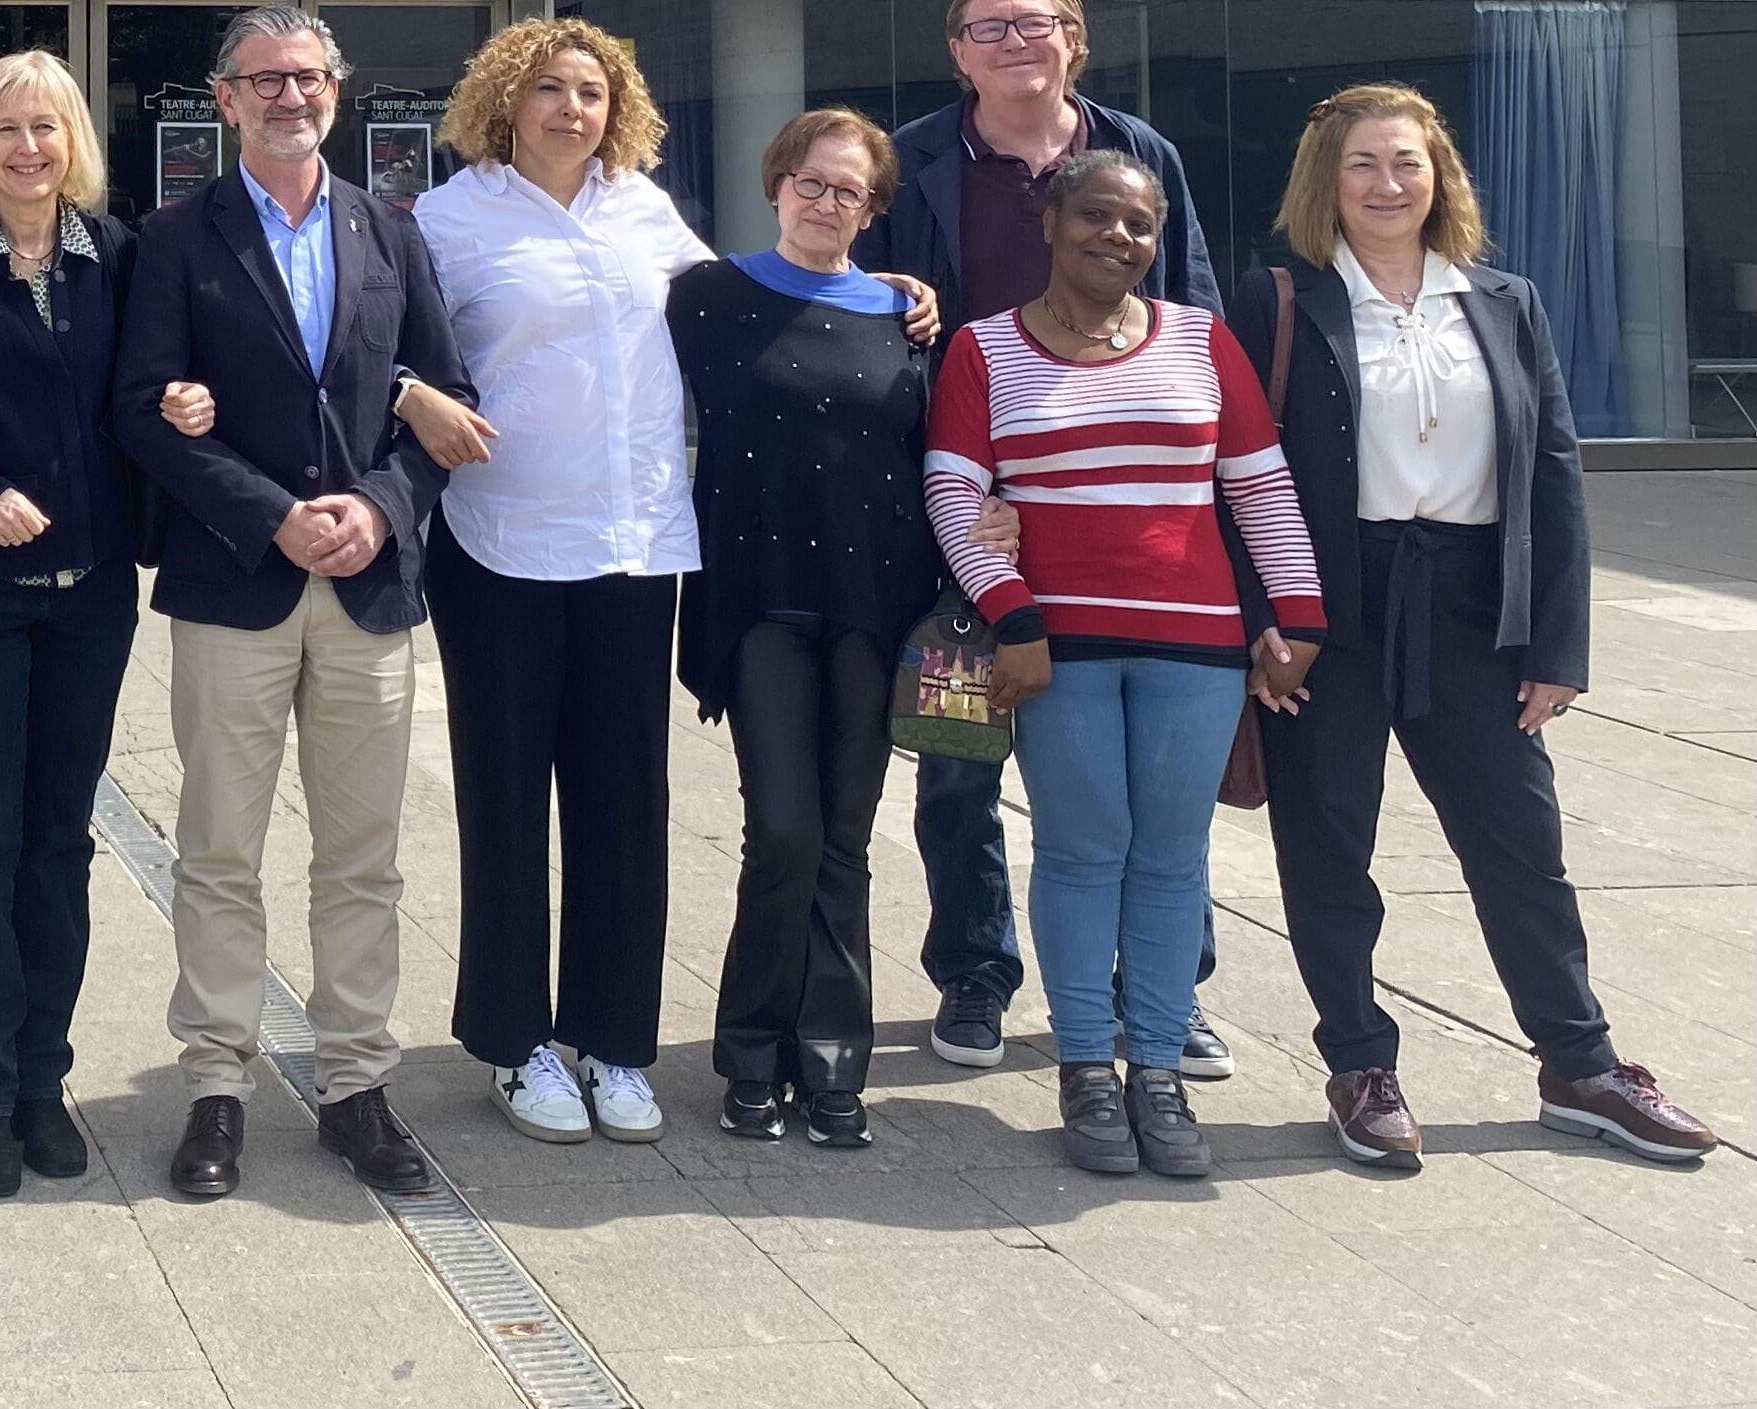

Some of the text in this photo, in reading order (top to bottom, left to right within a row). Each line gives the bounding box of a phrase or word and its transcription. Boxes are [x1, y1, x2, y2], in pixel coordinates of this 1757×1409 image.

[371, 100, 449, 111] TEATRE-AUDITOR
[160, 110, 214, 121] SANT CUGAT
[371, 111, 425, 121] SANT CUGAT
